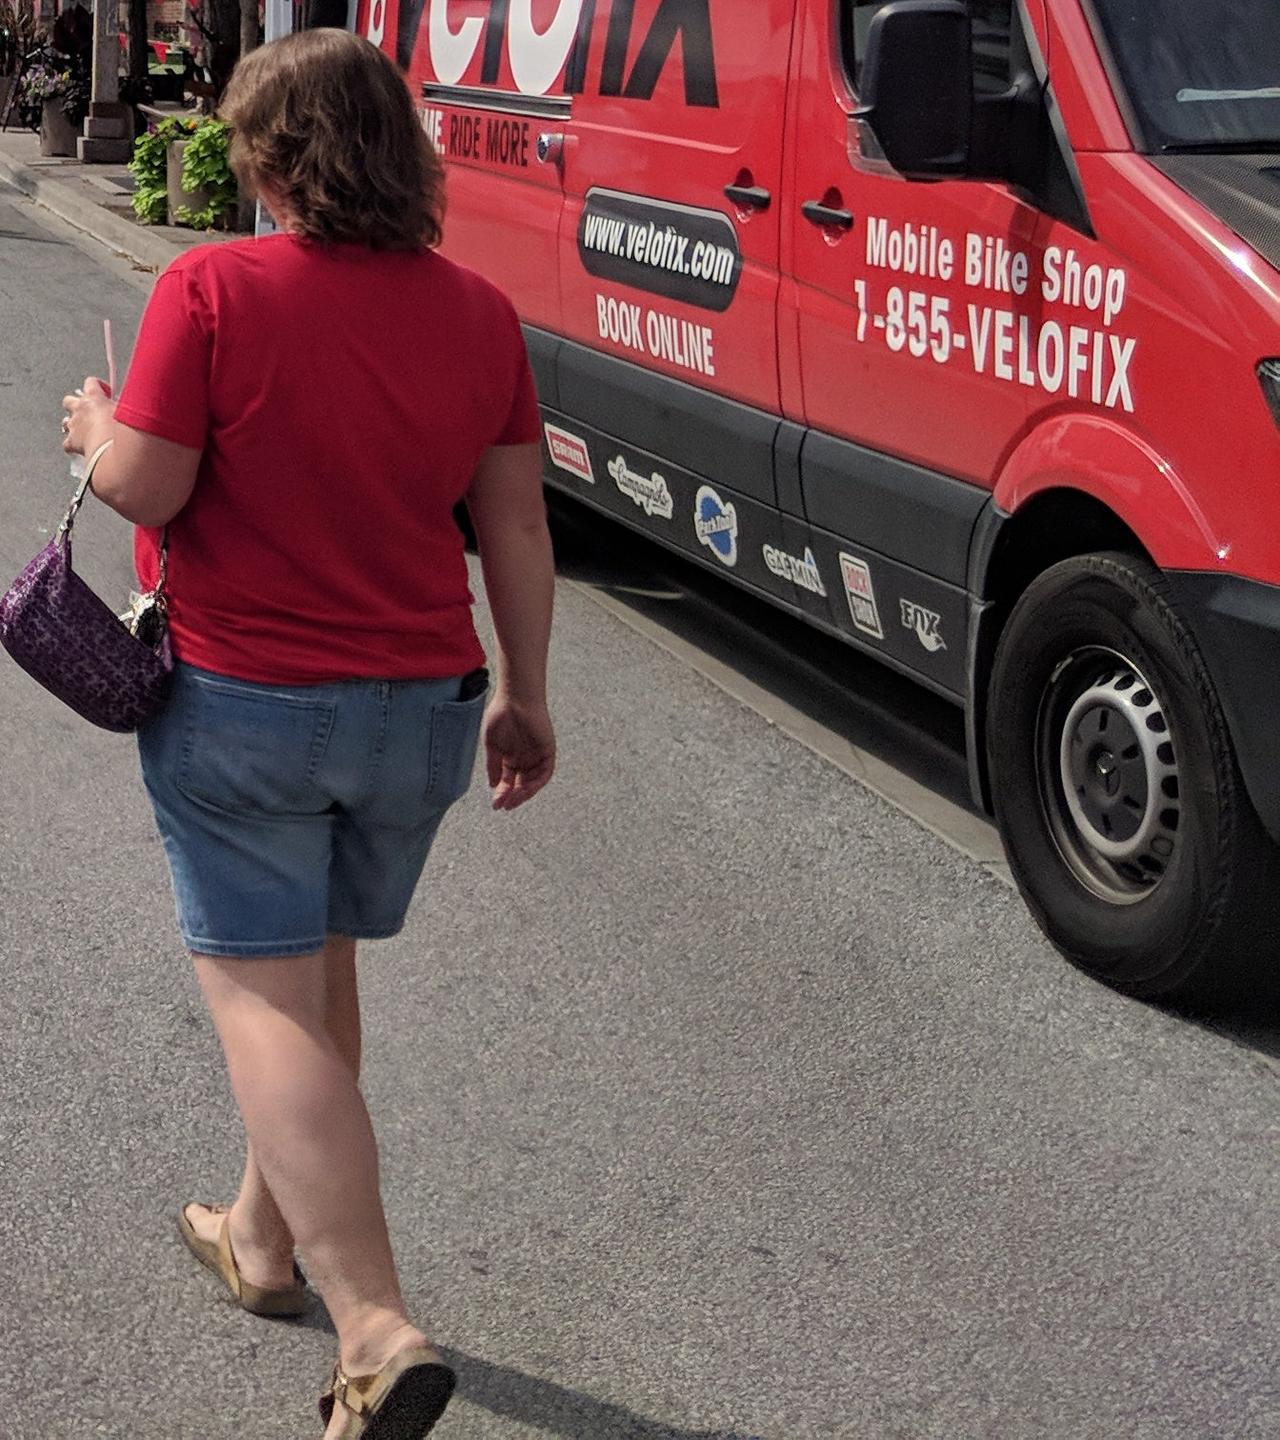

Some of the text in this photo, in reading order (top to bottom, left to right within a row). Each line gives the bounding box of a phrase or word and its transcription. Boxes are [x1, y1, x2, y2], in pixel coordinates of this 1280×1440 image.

[449, 114, 481, 160] RIDE
[486, 119, 530, 167] MORE
[584, 214, 735, 285] www.velofix.com
[866, 216, 1126, 326] Mobile Bike Shop
[596, 294, 715, 376] BOOK ONLINE
[854, 279, 1136, 413] 1-855-VELOFIX
